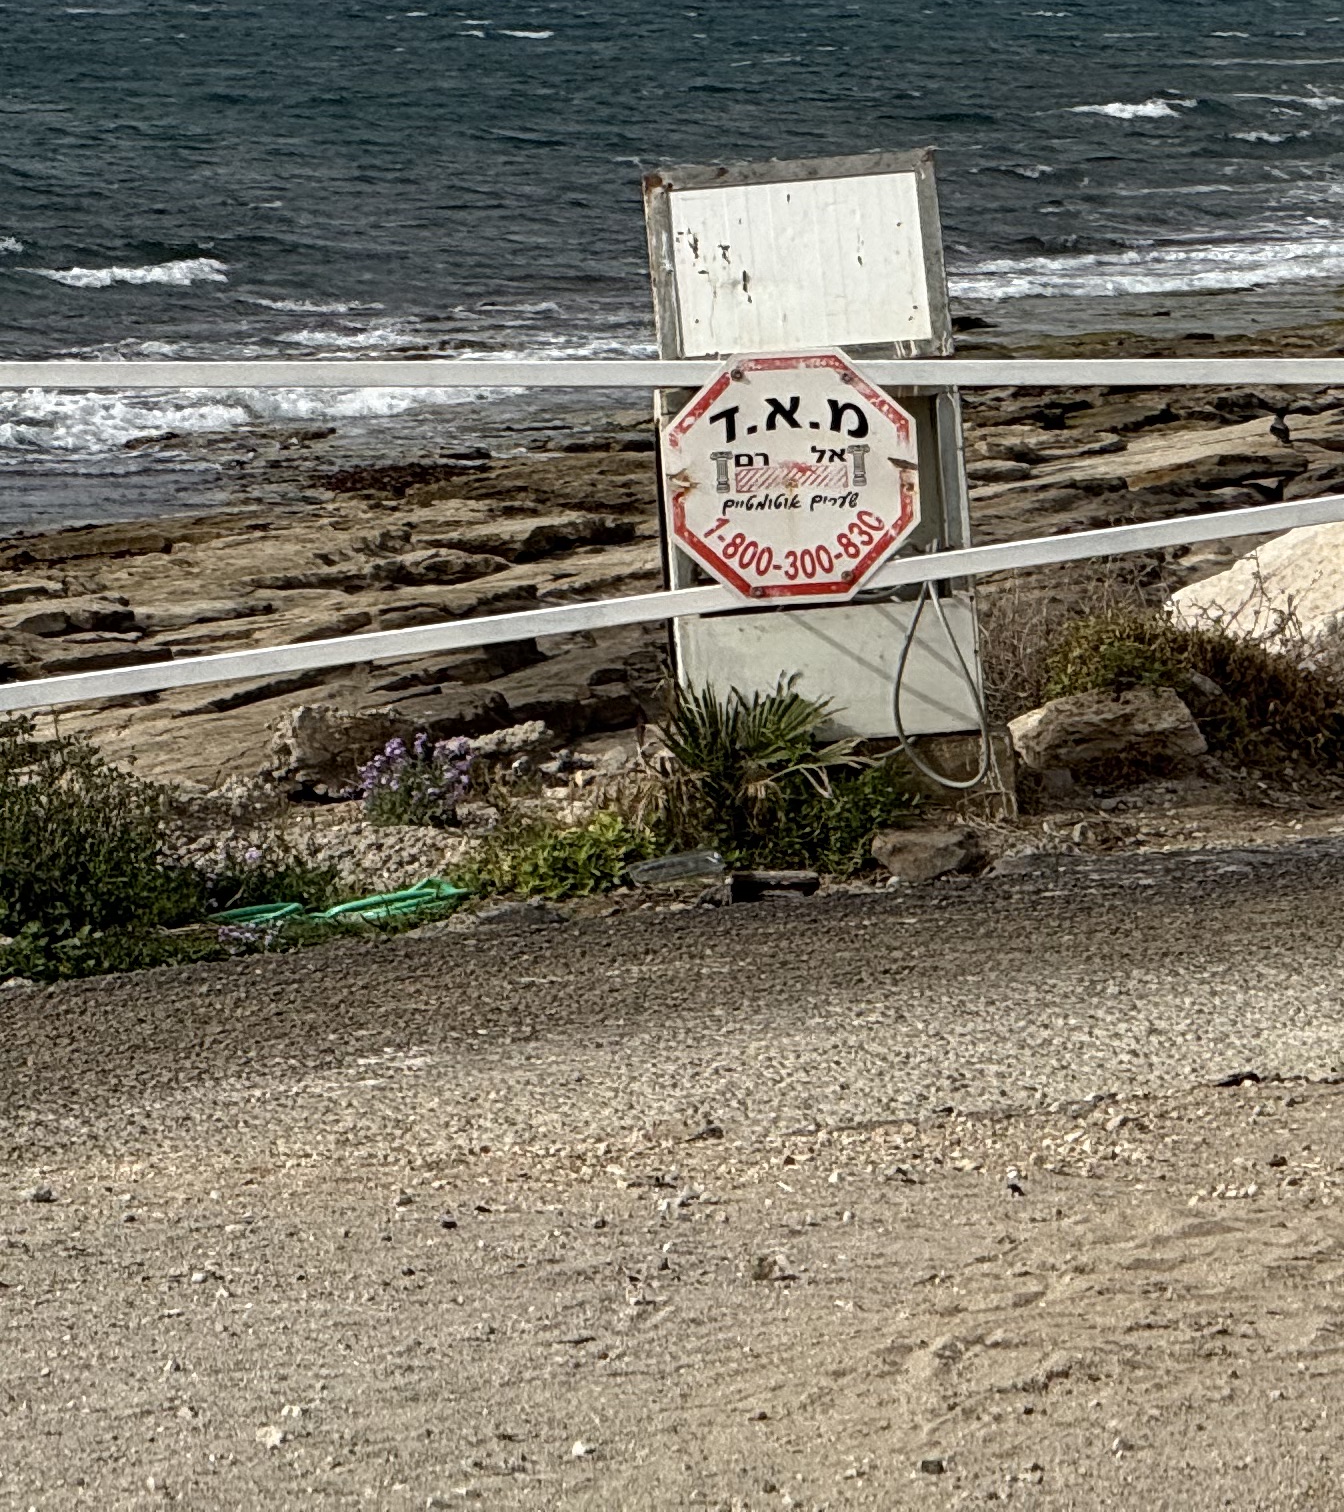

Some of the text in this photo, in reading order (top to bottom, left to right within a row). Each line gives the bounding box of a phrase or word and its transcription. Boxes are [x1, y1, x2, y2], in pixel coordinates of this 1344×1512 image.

[735, 445, 847, 467] אל רם
[722, 492, 859, 516] שערים אוטומטיים
[703, 510, 885, 581] 1-800-300-830
